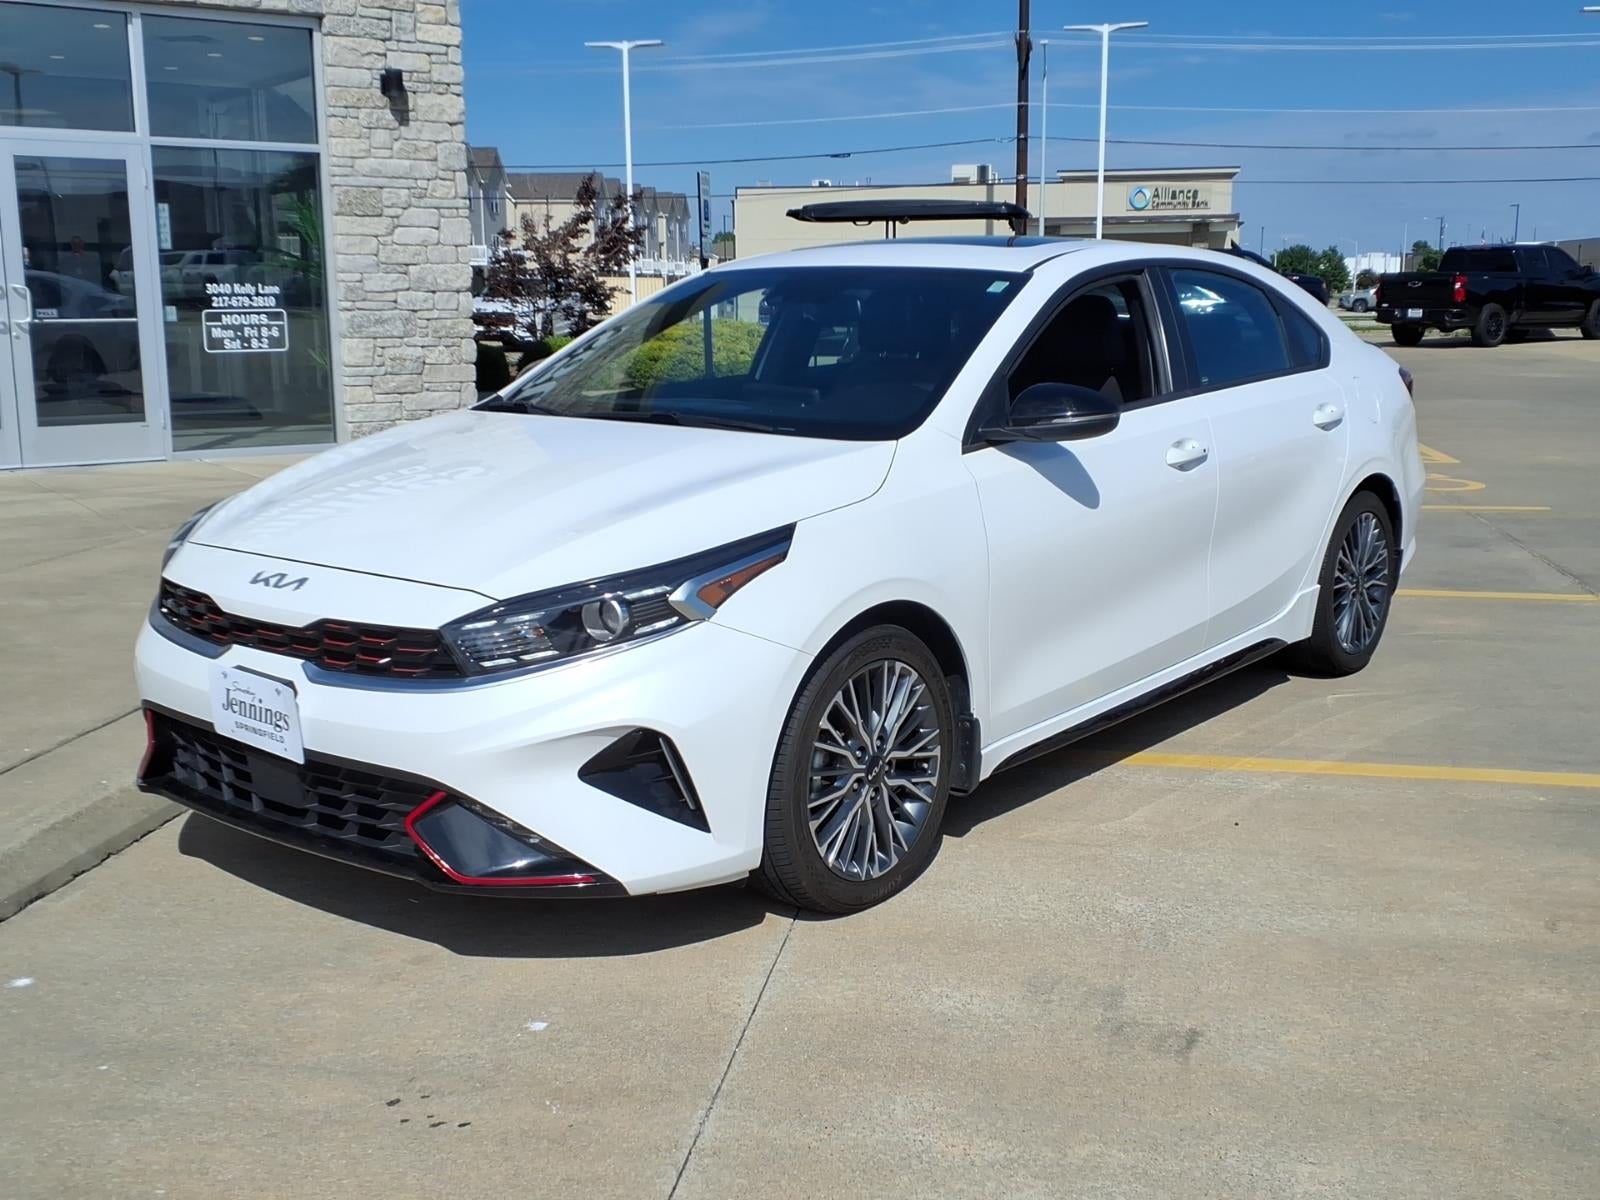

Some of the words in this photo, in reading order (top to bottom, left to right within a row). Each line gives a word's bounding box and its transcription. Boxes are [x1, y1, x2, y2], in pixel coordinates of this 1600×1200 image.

[1152, 187, 1199, 200] Alliance
[1152, 200, 1189, 208] Community
[1191, 200, 1209, 208] Bank
[205, 283, 231, 294] 3040
[233, 283, 256, 295] Kelly
[257, 283, 280, 294] Lane
[221, 314, 268, 325] HOURS
[211, 327, 235, 338] Mon
[243, 327, 259, 338] Fri
[260, 327, 280, 338] 8-6
[223, 338, 242, 349] Sat
[250, 338, 269, 349] 8-2
[222, 688, 290, 733] Jennings
[234, 720, 285, 744] SPRINGFIELD
